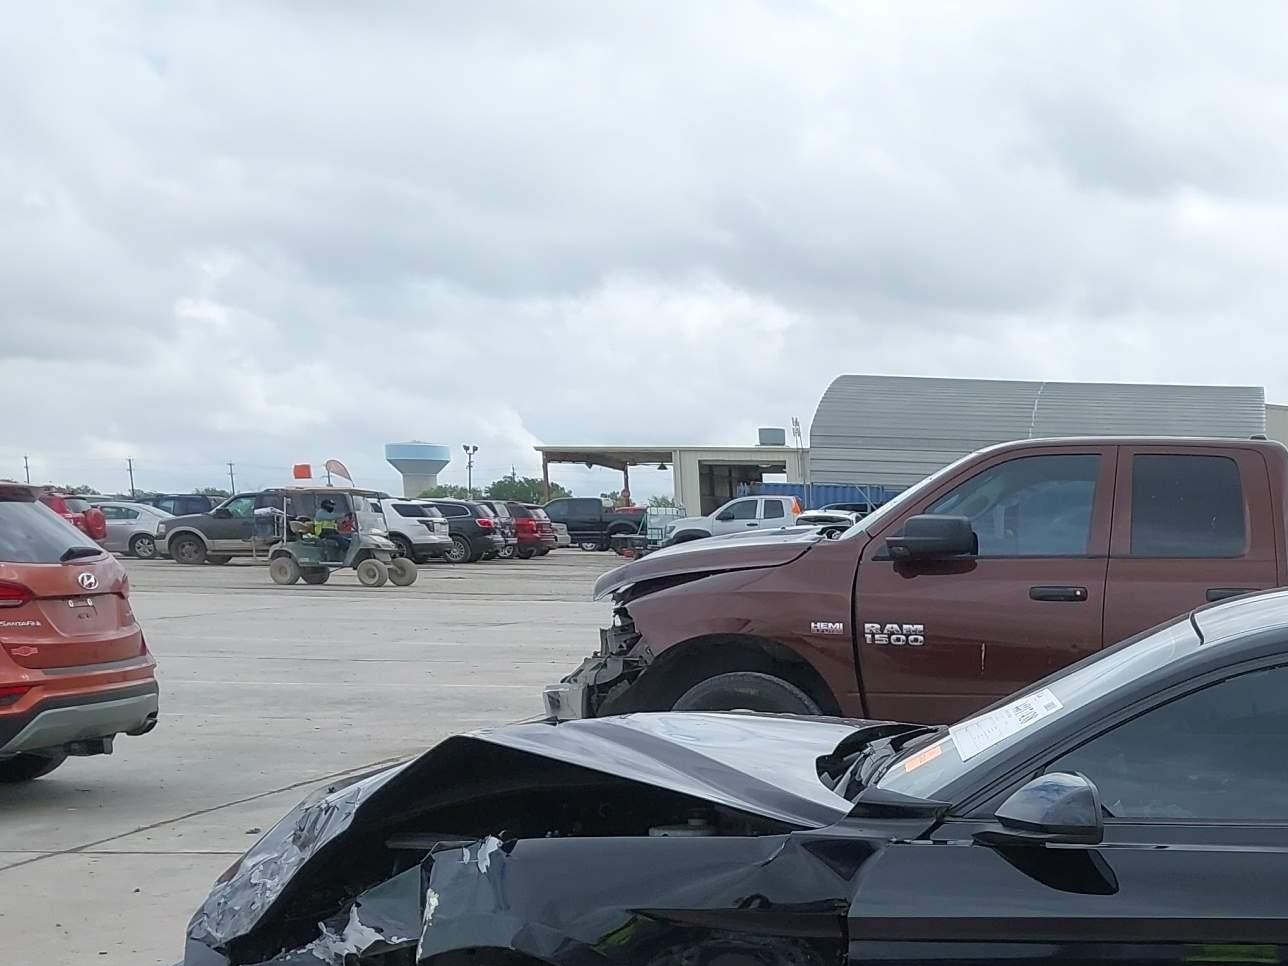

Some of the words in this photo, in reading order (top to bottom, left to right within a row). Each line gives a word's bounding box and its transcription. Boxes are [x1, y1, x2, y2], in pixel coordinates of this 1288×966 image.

[810, 621, 844, 630] HEMI
[864, 623, 925, 634] RAM
[864, 634, 925, 646] 1500
